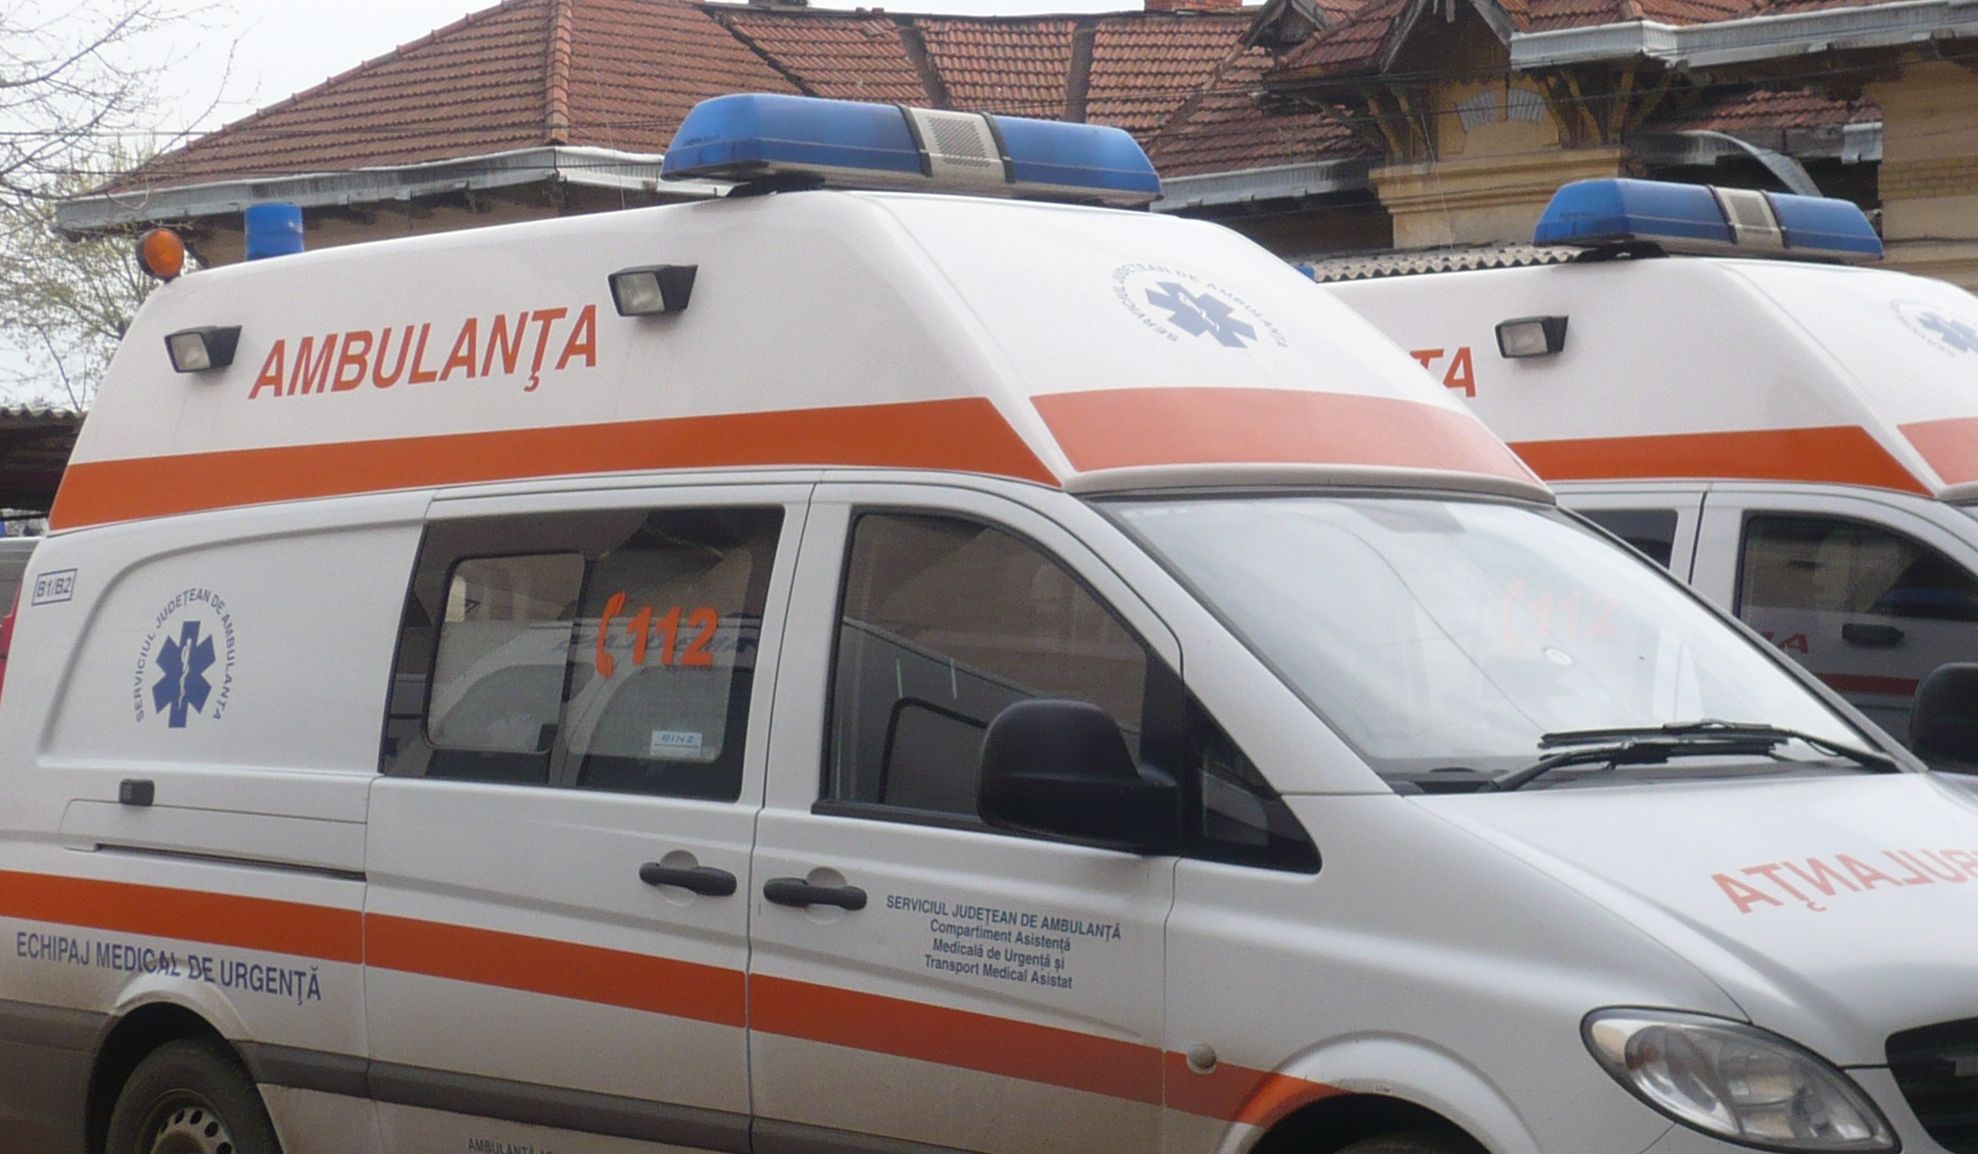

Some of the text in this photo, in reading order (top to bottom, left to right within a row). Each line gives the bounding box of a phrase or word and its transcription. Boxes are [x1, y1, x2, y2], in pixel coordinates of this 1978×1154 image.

[37, 577, 72, 597] B1/B2
[626, 606, 719, 668] 112
[133, 632, 157, 722] SERVICIUL
[210, 594, 226, 615] DE
[886, 894, 949, 916] SERVICIUL
[1021, 913, 1037, 928] DE
[930, 918, 1011, 944] Compartiment
[16, 931, 91, 965] ECHIPAJ
[96, 941, 182, 977] MEDICAL
[188, 954, 215, 983] DE
[986, 945, 1000, 961] de
[925, 954, 1073, 989] Transport Medical Asistat
